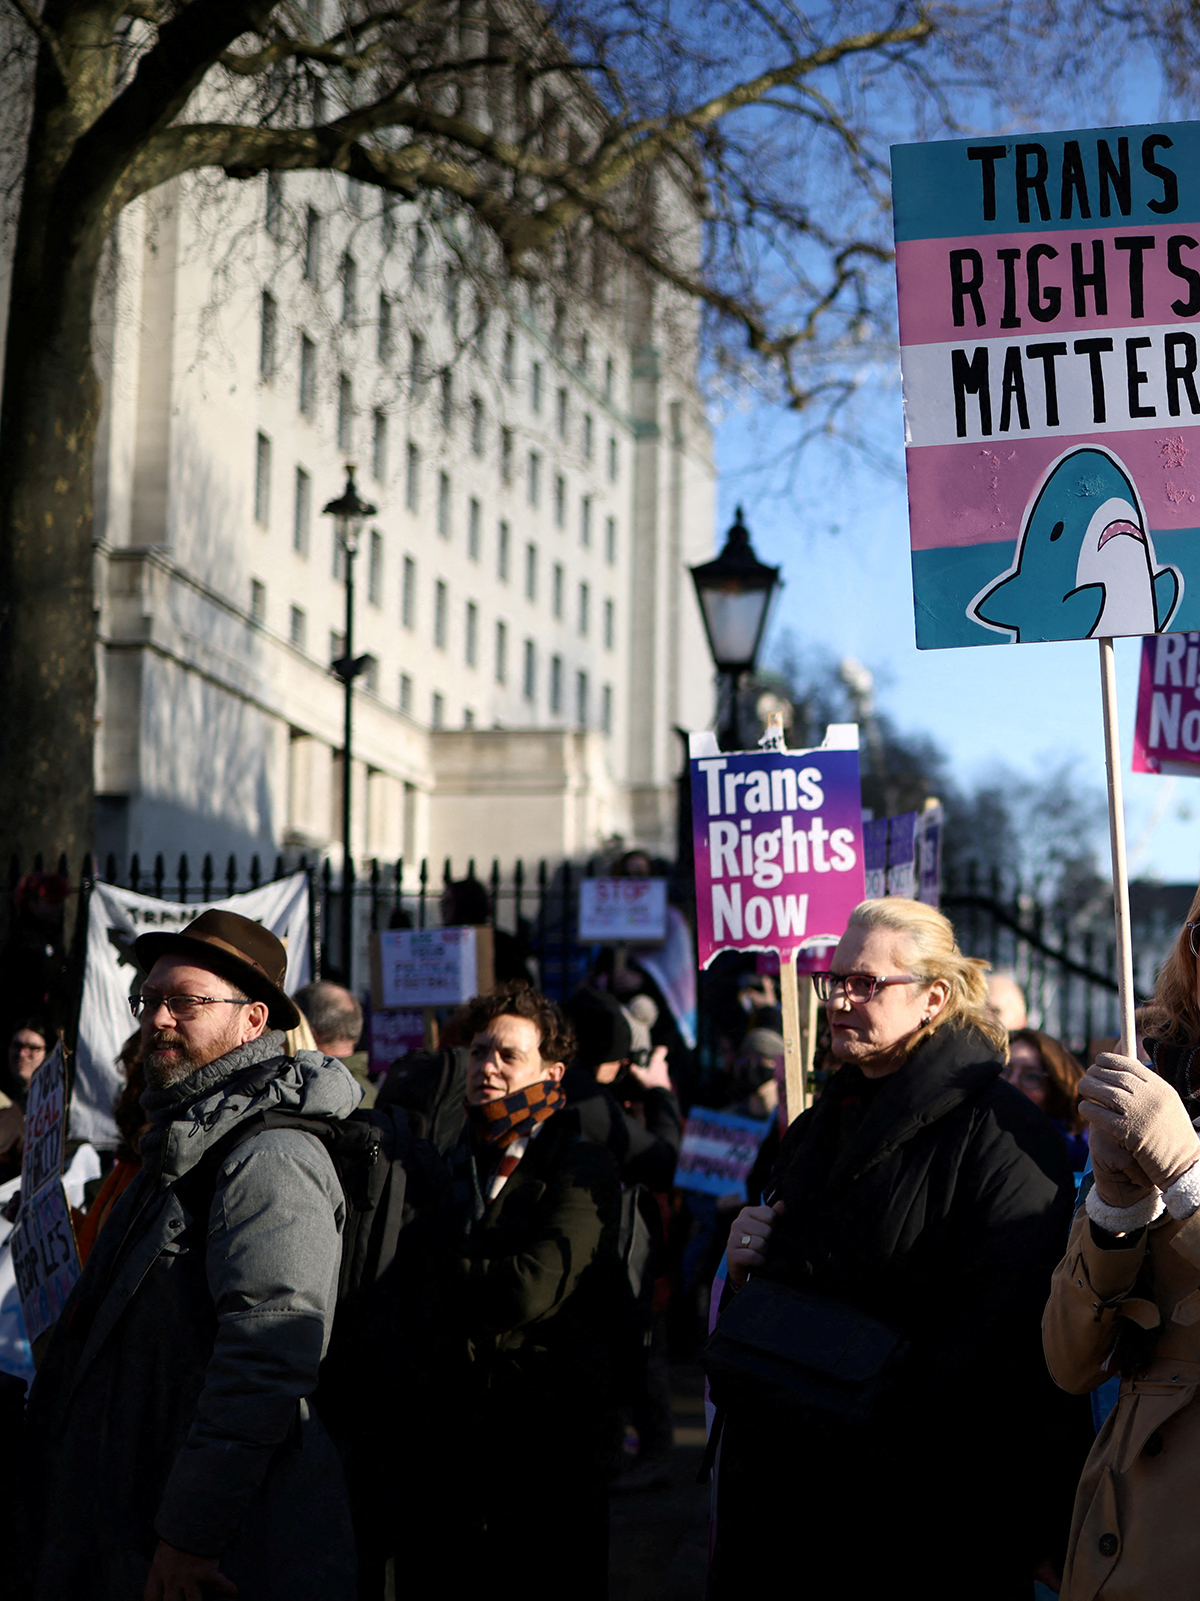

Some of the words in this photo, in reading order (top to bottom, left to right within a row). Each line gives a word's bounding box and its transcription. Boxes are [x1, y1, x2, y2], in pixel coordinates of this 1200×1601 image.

[967, 133, 1179, 223] TRANS
[698, 758, 825, 816] Trans
[708, 815, 857, 889] Rights
[126, 907, 199, 925] TRAN
[595, 877, 651, 905] STOP
[711, 882, 809, 942] Now
